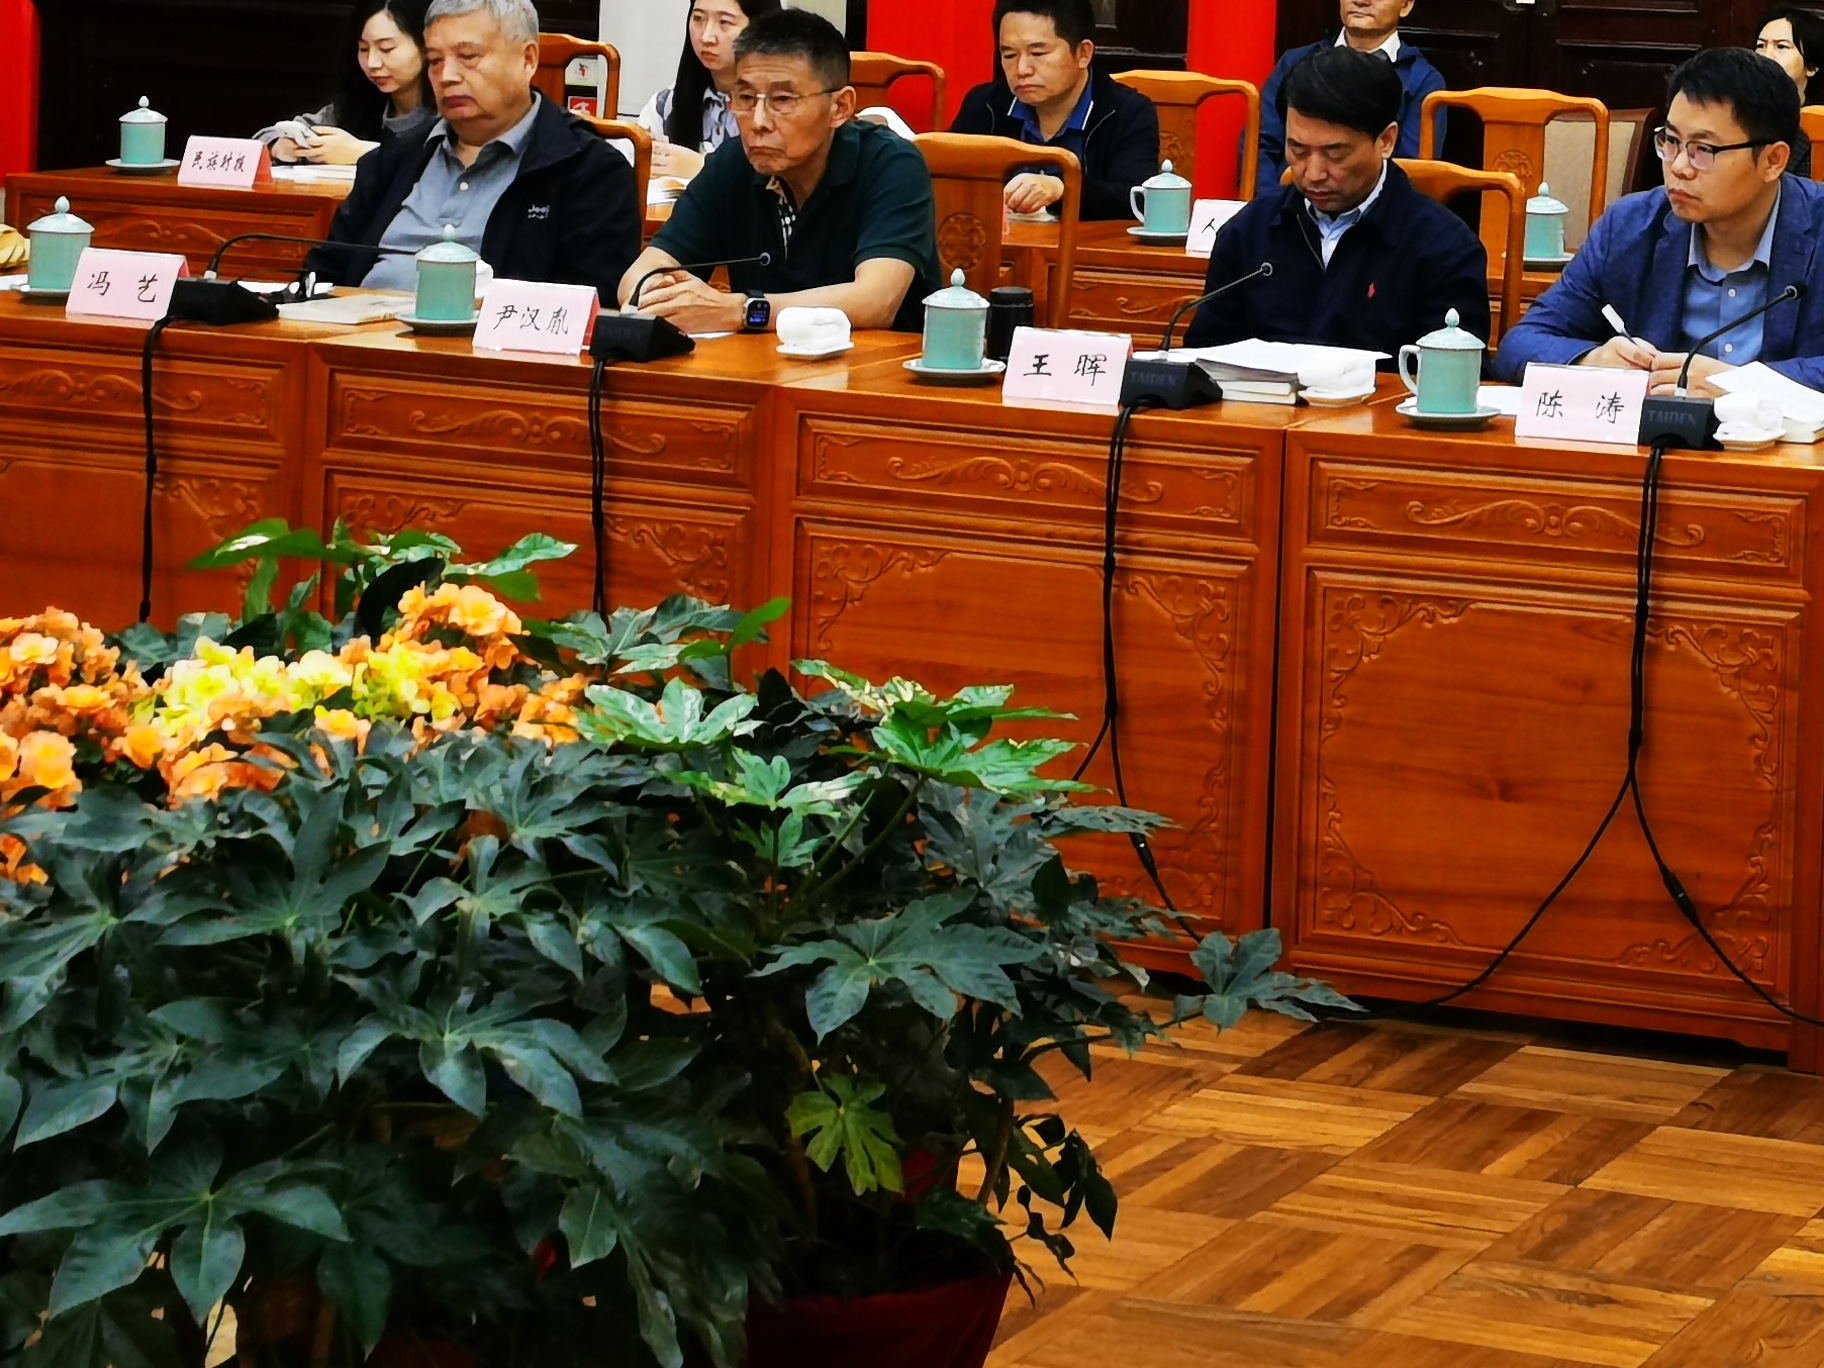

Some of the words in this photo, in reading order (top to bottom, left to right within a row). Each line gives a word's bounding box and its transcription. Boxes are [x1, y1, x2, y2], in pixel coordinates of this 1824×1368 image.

[87, 271, 158, 303] 冯艺
[493, 304, 569, 335] 尹汉胤
[1023, 353, 1108, 387] 王晖
[1131, 371, 1177, 387] TAIDEN
[1536, 389, 1625, 425] 陈涛
[1648, 409, 1697, 427] TAIDEN
